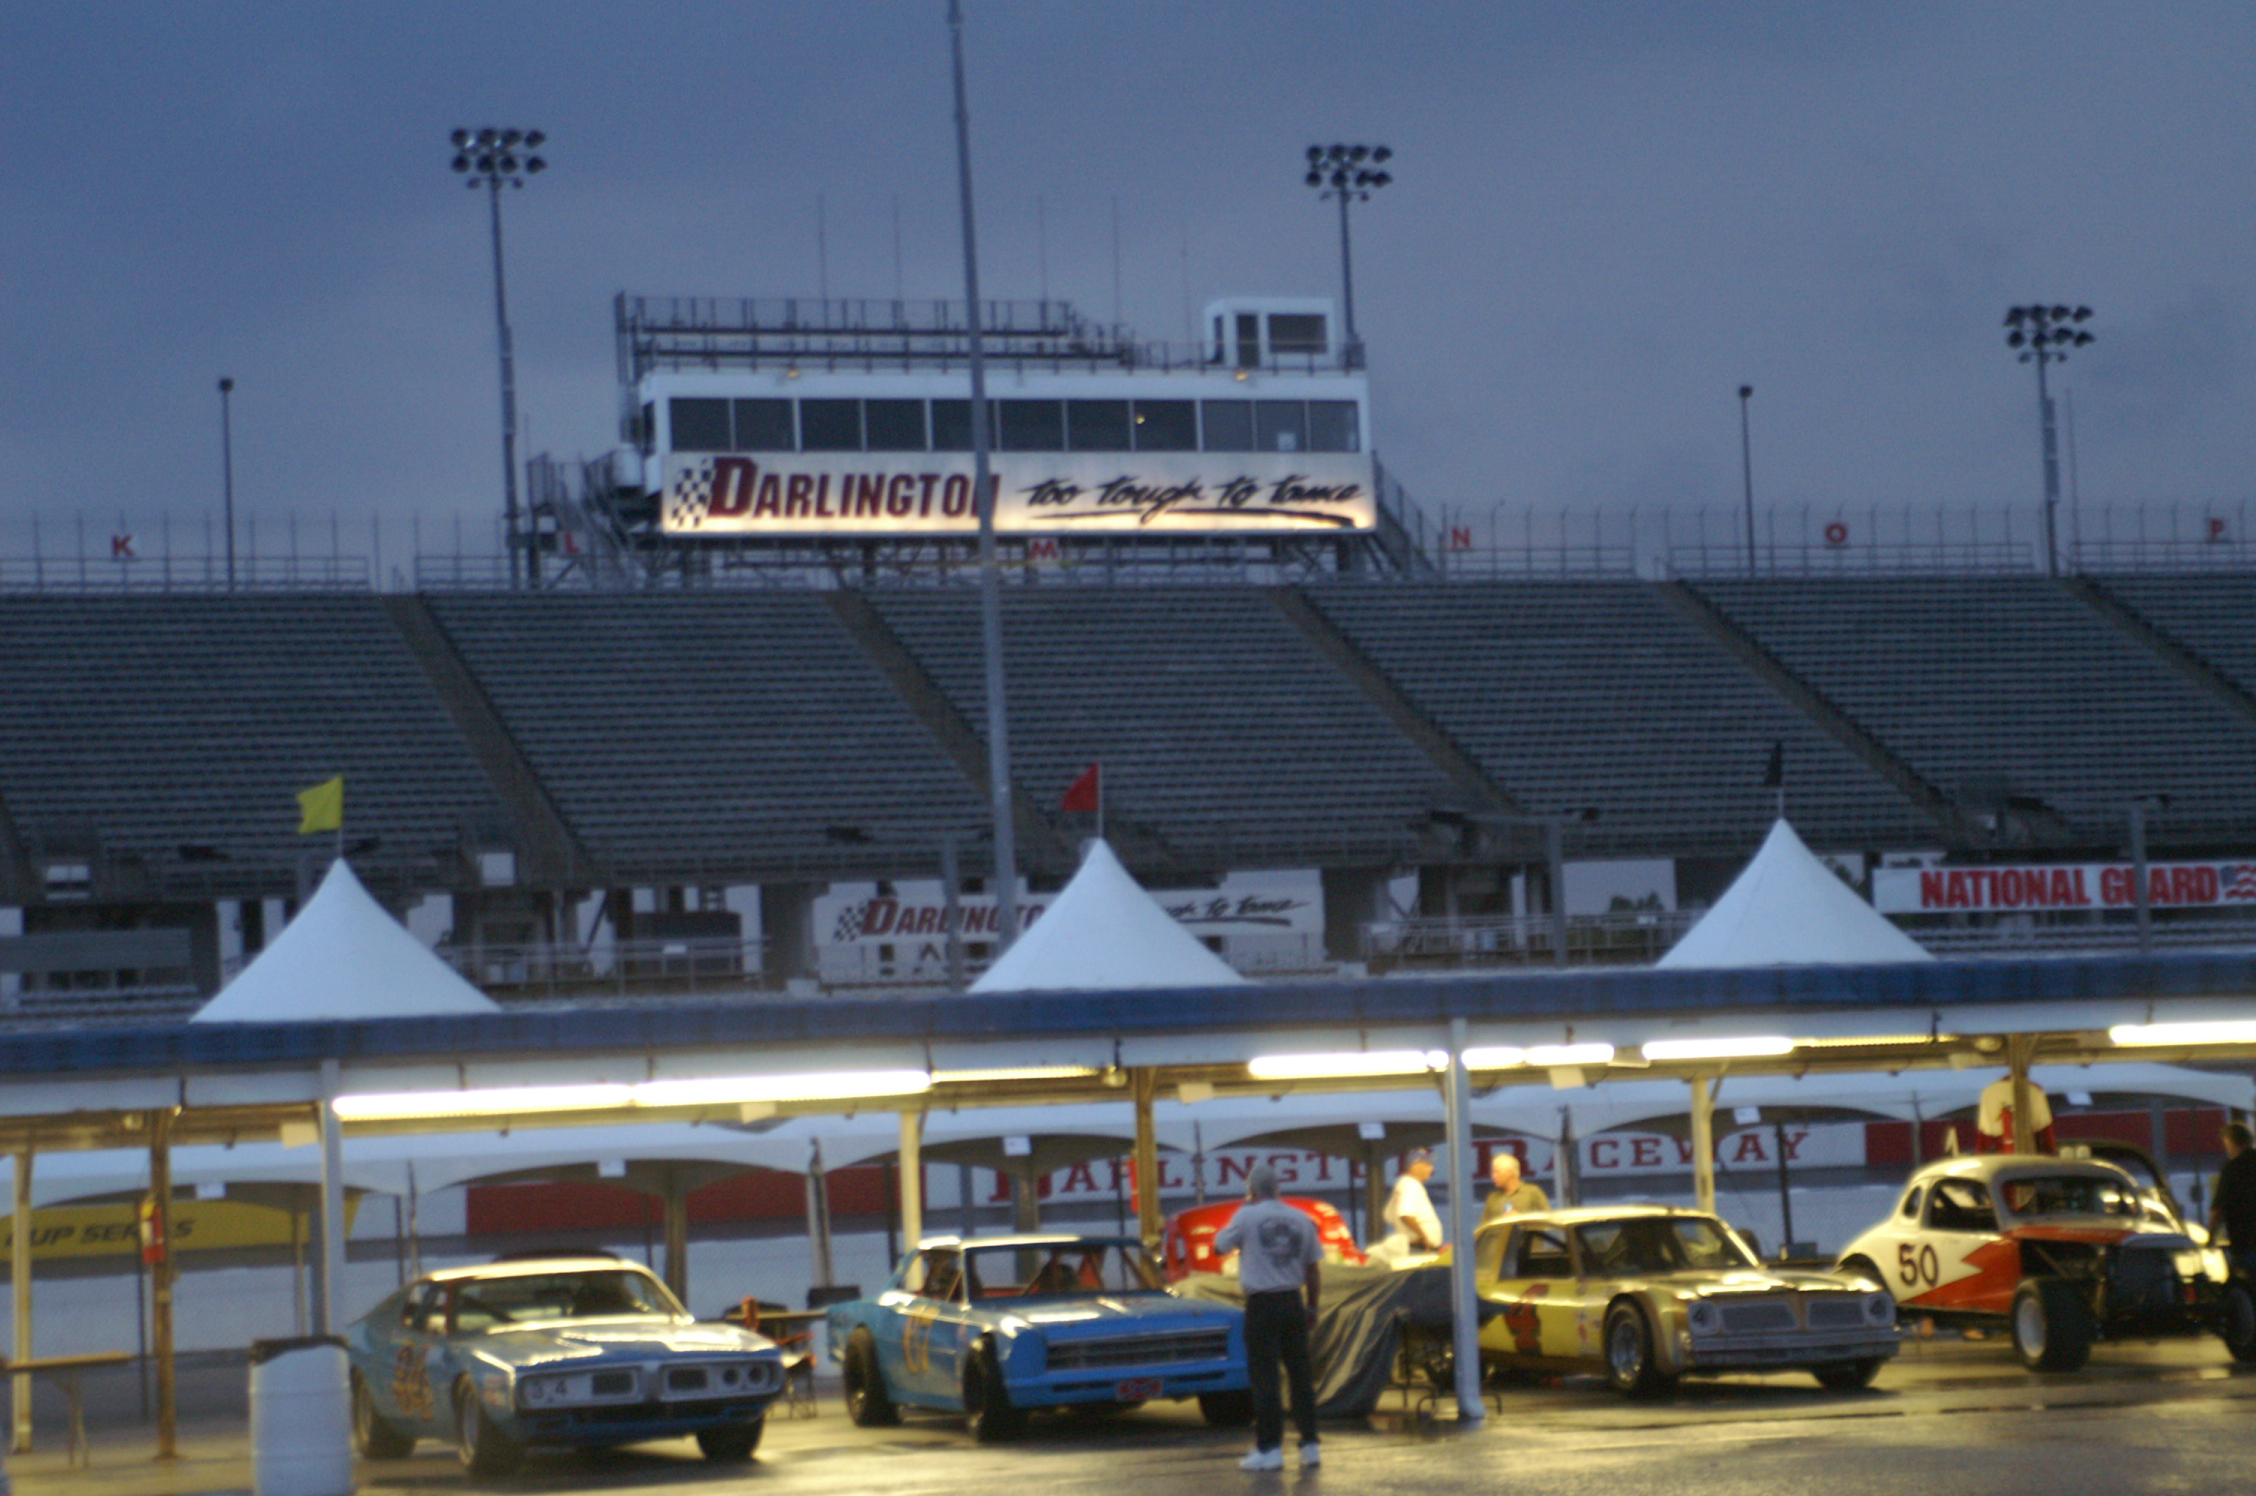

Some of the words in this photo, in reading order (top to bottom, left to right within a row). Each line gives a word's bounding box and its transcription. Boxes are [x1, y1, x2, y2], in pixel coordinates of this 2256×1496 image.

[1019, 478, 1084, 507] too
[1097, 474, 1205, 525] tough
[1214, 475, 1262, 508] to
[1270, 474, 1364, 504] tame
[1451, 527, 1471, 549] N
[1826, 523, 1847, 544] O
[112, 535, 134, 558] K
[1031, 541, 1058, 561] M
[1920, 868, 2092, 908] NATIONAL
[1897, 1243, 1940, 1288] 50
